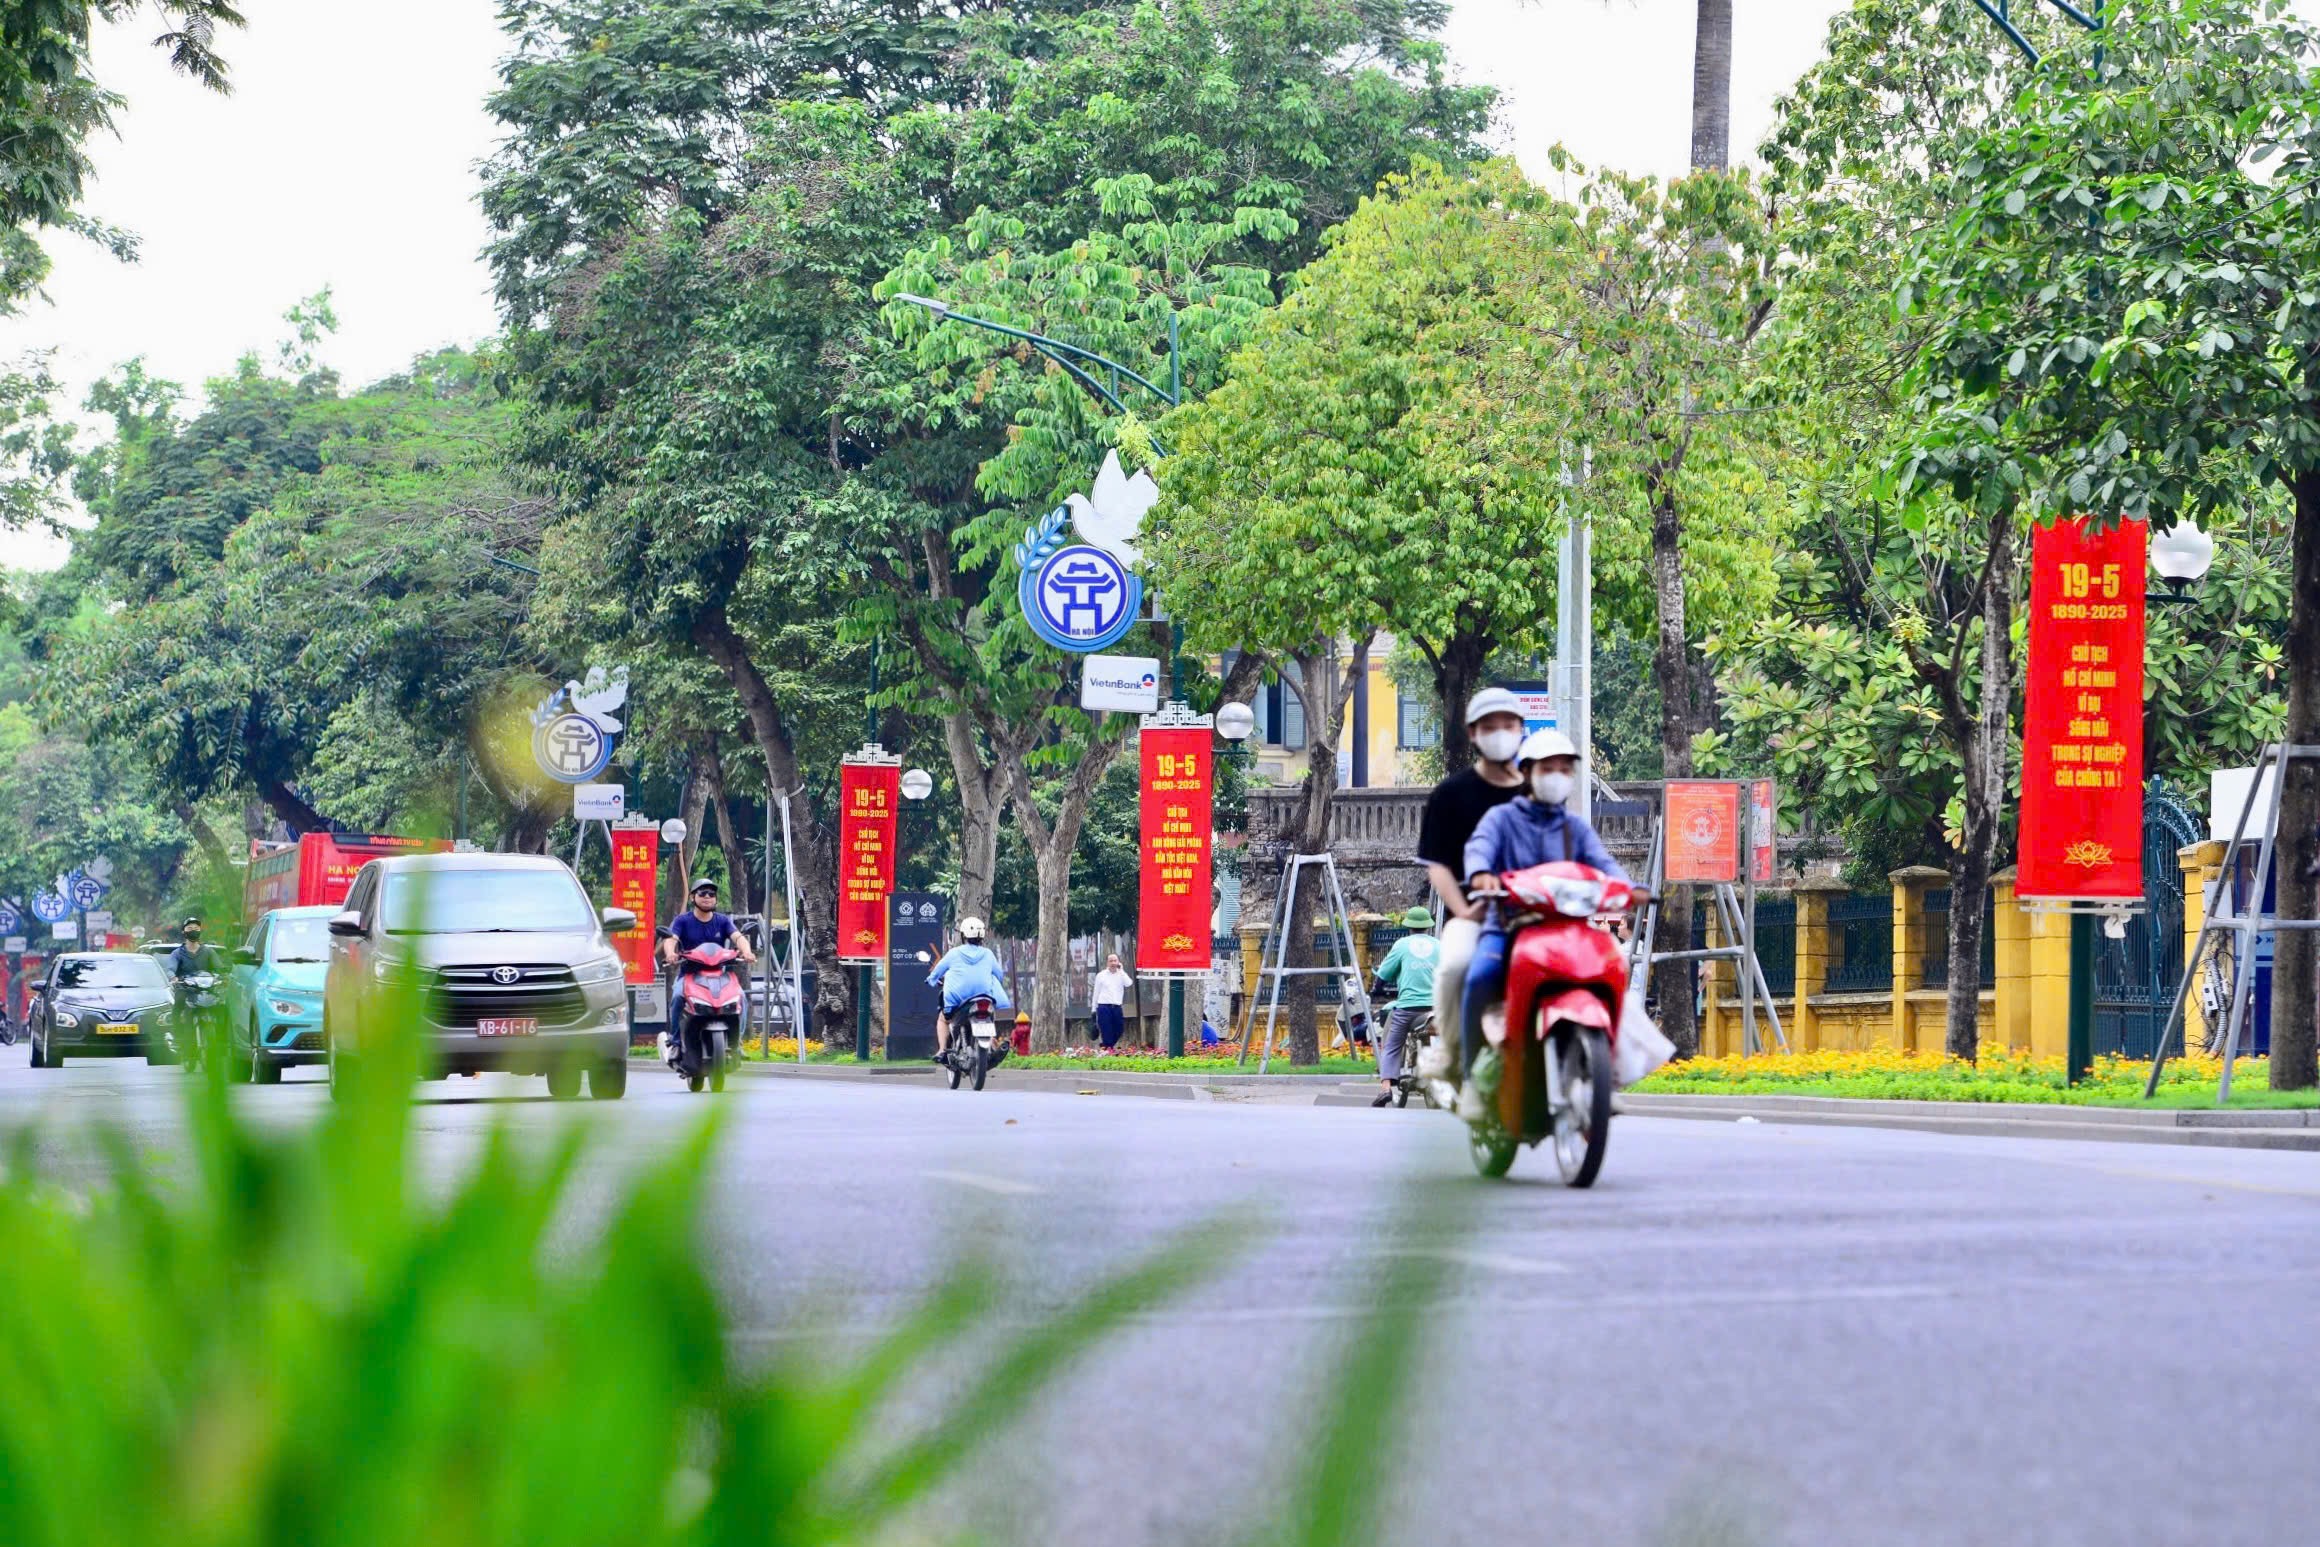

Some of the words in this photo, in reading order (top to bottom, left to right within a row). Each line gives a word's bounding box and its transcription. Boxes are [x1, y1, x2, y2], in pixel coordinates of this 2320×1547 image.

[2059, 563, 2120, 598] 19-5
[2051, 604, 2127, 619] 1890-2025
[1090, 678, 1142, 689] VietinBank
[2051, 745, 2080, 761] TRONG
[2094, 742, 2127, 766] NGHIỆP
[1157, 754, 1196, 777] 19-5
[1152, 780, 1201, 790] 1890-2025
[855, 788, 885, 807] 19-5
[622, 846, 648, 861] 19-5
[480, 1020, 536, 1034] KB-61-16
